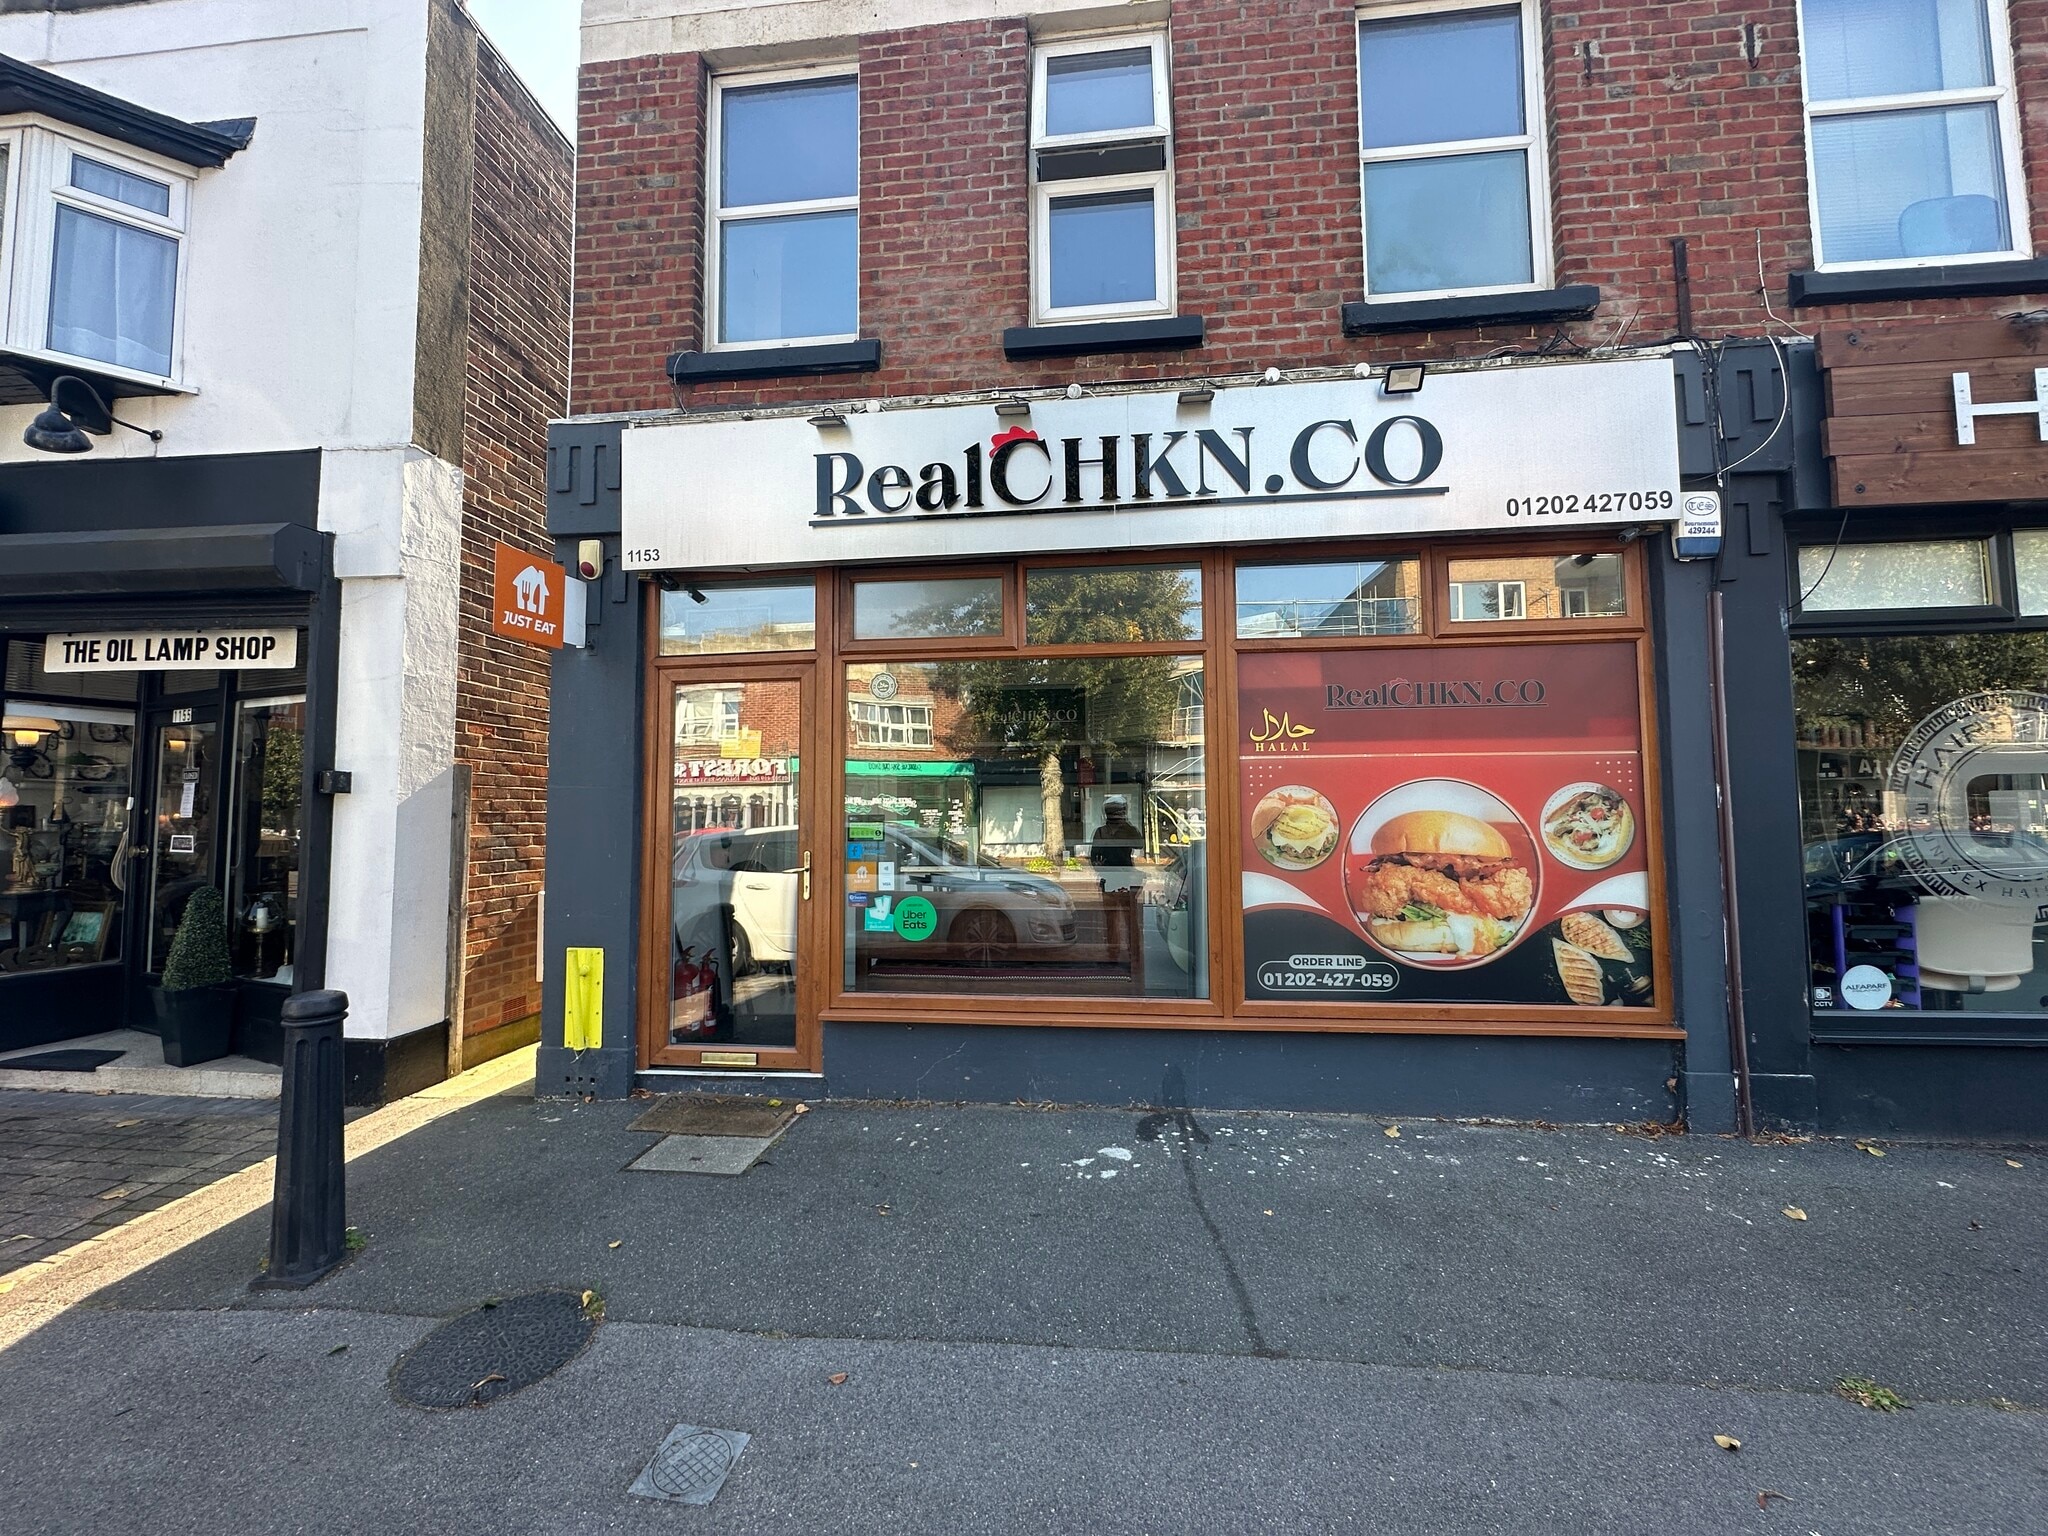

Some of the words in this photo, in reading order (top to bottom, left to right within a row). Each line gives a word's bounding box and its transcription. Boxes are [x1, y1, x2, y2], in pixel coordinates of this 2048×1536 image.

[812, 415, 1444, 516] RealCHKN.CO
[1506, 494, 1580, 517] 01202
[1583, 490, 1673, 513] 427059
[1687, 526, 1716, 535] 429244
[627, 548, 660, 563] 1153
[502, 610, 533, 629] JUST
[534, 620, 557, 635] EAT
[62, 640, 101, 664] THE
[106, 638, 138, 662] OIL
[144, 637, 210, 661] LAMP
[215, 636, 276, 660] SHOP
[1325, 679, 1546, 708] RealCHKN.CO
[173, 708, 192, 723] 1155
[1249, 707, 1316, 741] حلال
[1254, 742, 1311, 752] HALAL
[902, 909, 927, 919] Uber
[902, 919, 928, 929] Eats
[1292, 957, 1333, 967] ORDER
[1336, 957, 1363, 967] LINE
[1263, 972, 1394, 988] 01202-427-059
